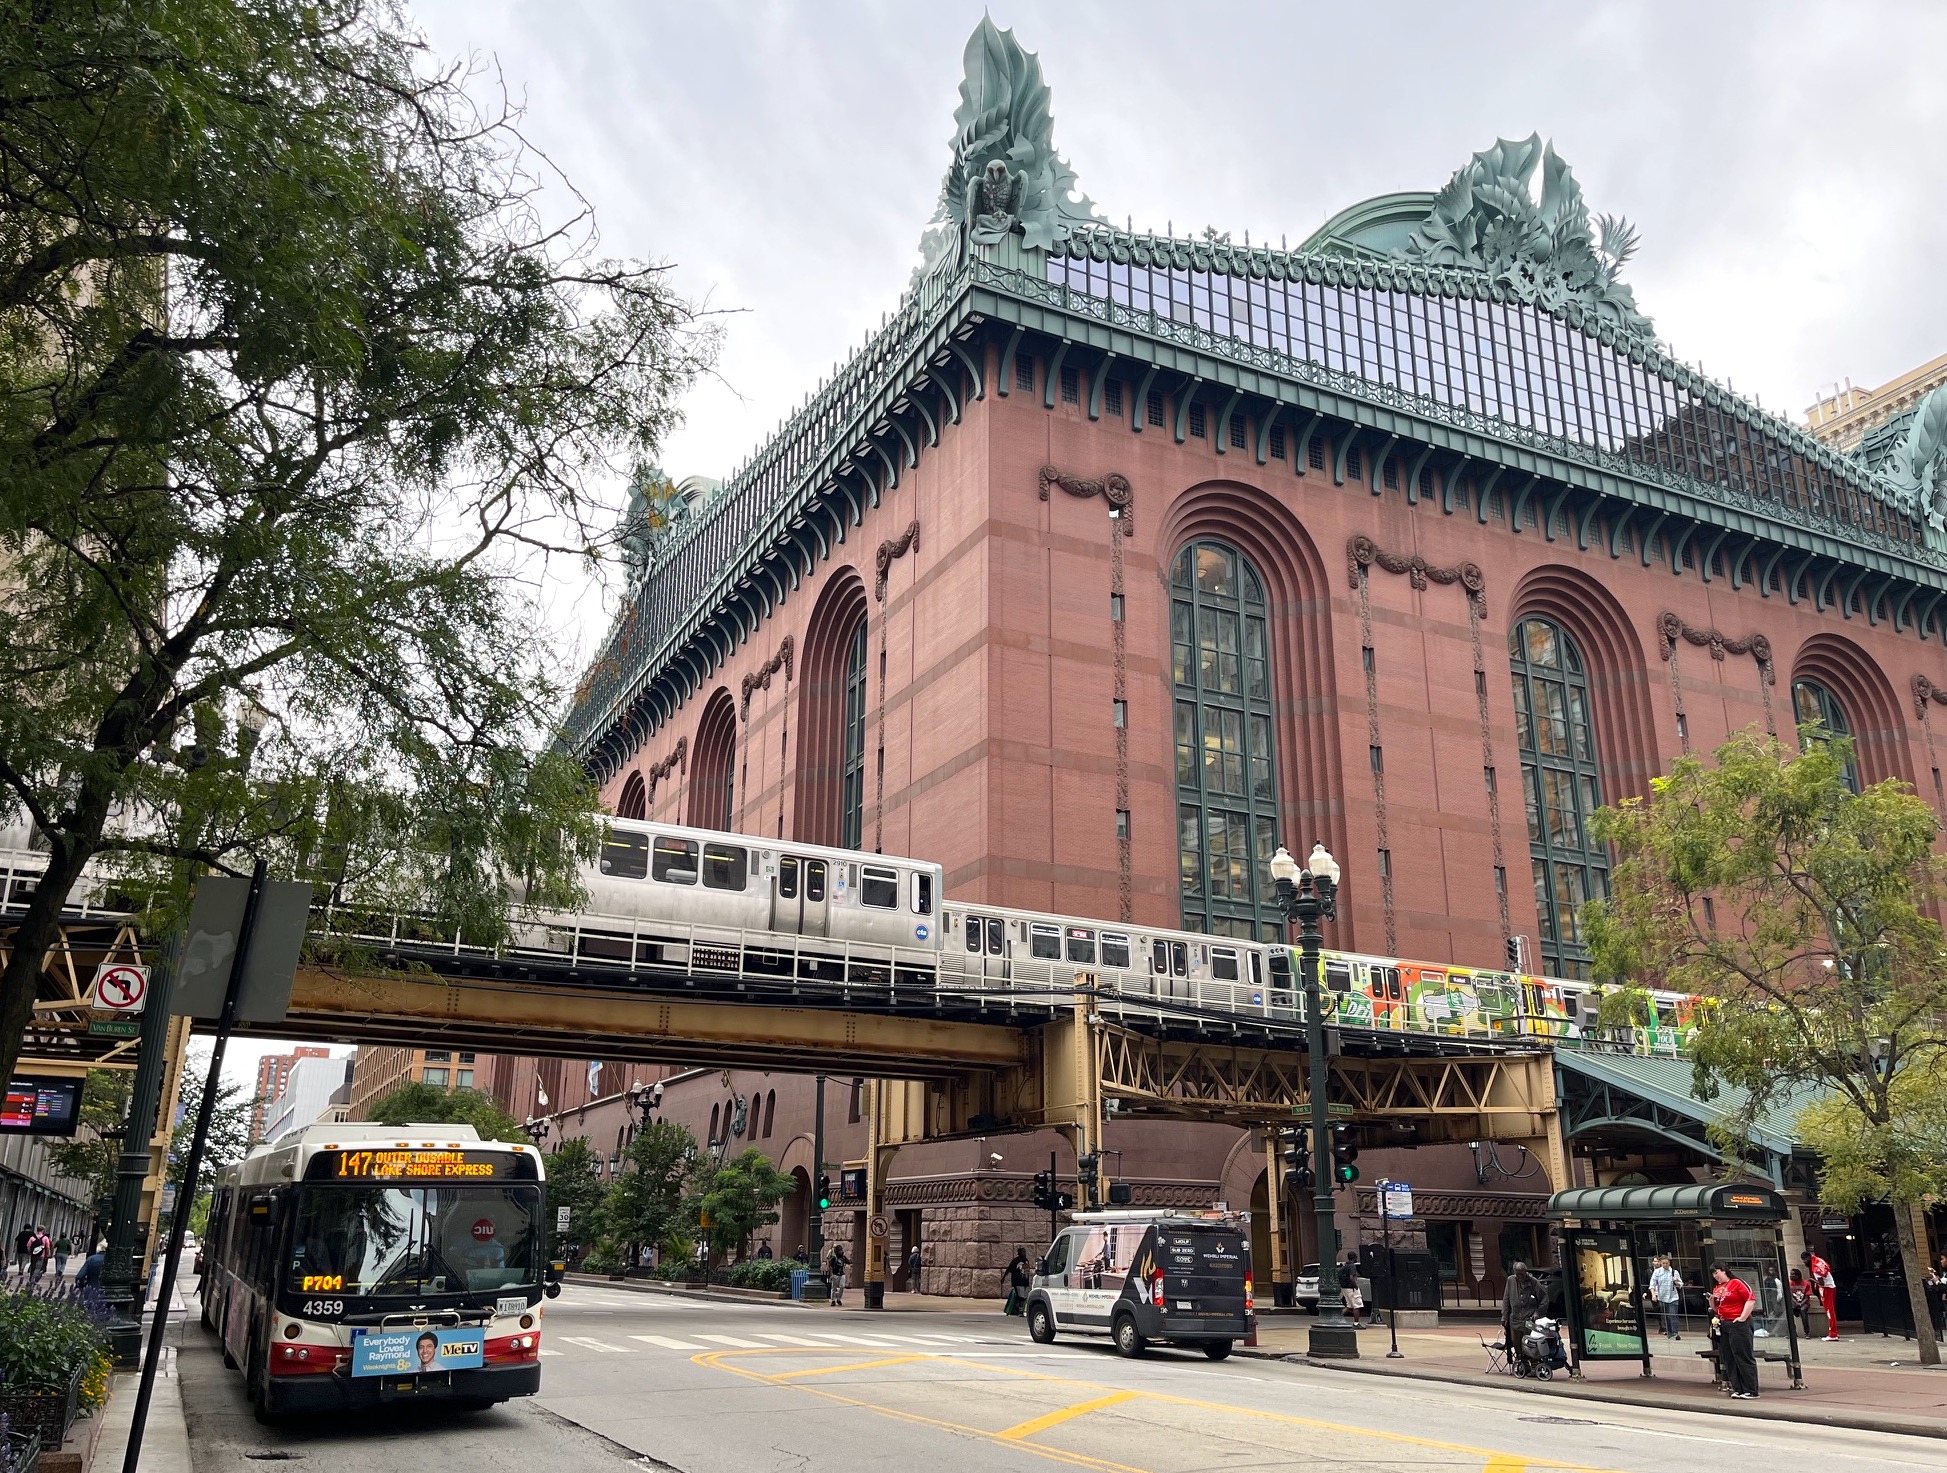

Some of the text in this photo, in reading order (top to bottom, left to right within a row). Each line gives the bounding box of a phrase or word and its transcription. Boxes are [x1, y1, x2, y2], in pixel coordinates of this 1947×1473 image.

[338, 1152, 372, 1176] 147
[376, 1152, 465, 1164] OUTER DUSABLE
[374, 1164, 494, 1176] LAKE SHORE EXPRESS
[303, 1275, 342, 1291] P704
[303, 1300, 344, 1315] 4359
[363, 1336, 410, 1347] Everybody
[379, 1345, 404, 1353] Loves
[442, 1343, 478, 1356] MeTV
[369, 1350, 410, 1361] Raymond
